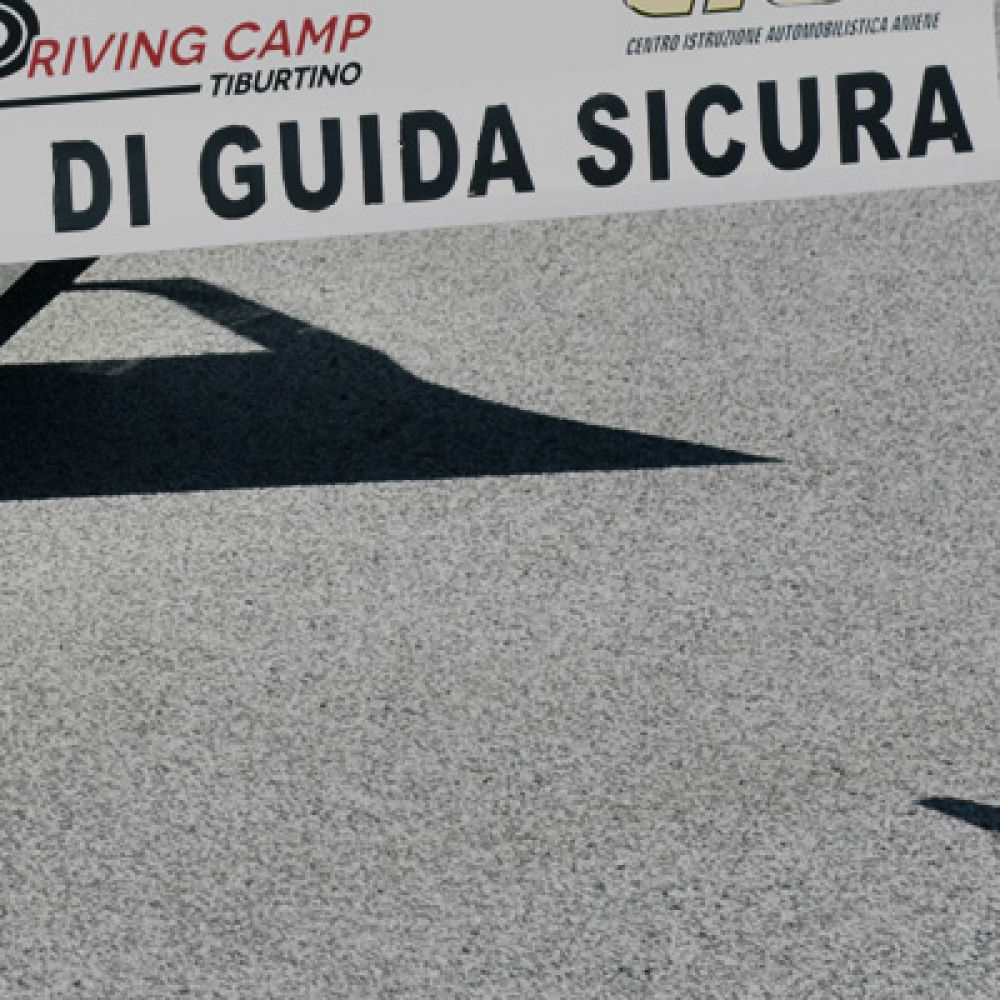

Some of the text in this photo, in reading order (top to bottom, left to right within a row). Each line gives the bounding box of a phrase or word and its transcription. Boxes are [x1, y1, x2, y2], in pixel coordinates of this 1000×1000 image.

[225, 12, 373, 61] CAMP
[625, 33, 681, 56] CENTRO
[683, 27, 763, 50] ISTRUZIONE
[210, 61, 364, 96] TIBURTINO
[50, 134, 151, 233] DI
[199, 102, 536, 220] GUIDA
[577, 64, 975, 188] SICURA
